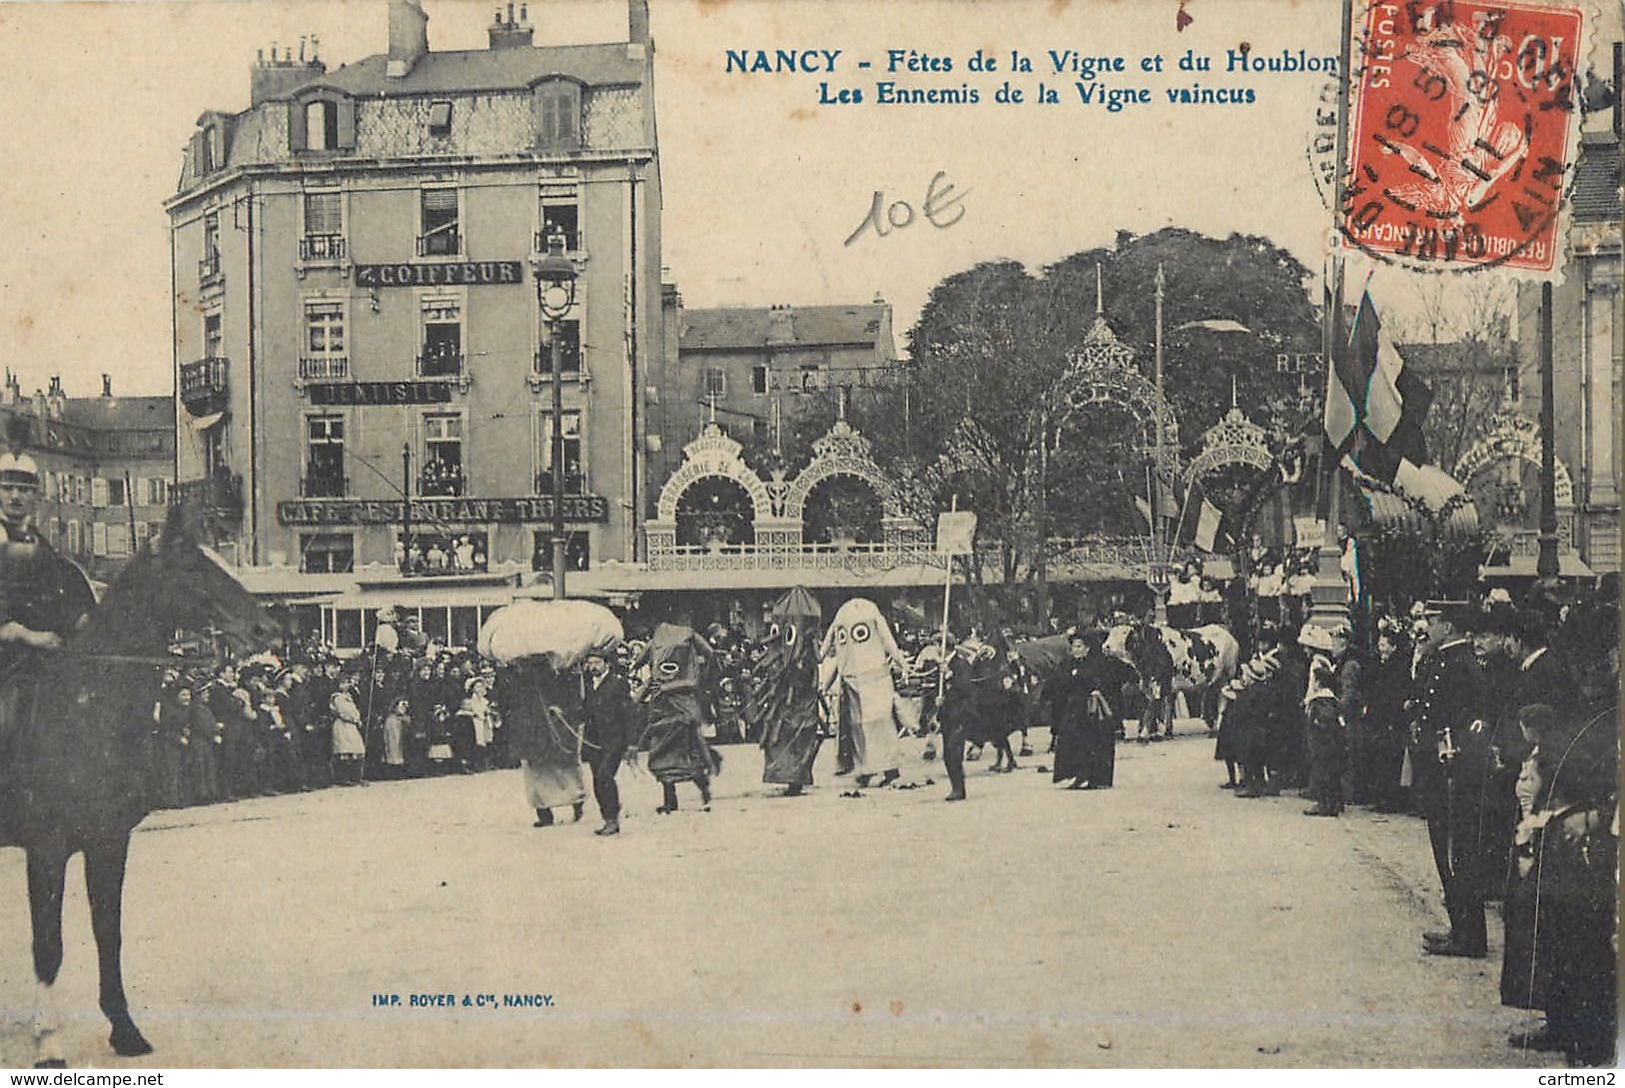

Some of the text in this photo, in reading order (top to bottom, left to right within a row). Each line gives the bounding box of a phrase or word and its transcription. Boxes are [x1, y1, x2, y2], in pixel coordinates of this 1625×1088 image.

[725, 48, 842, 74] NANCY
[888, 47, 953, 74] Fêtes
[967, 49, 997, 73] de
[1011, 49, 1034, 74] la
[1048, 48, 1127, 80] Vigne
[1139, 53, 1164, 74] et
[1178, 49, 1212, 73] du
[1226, 47, 1338, 74] Houblon
[819, 81, 1256, 113] Les Ennemis de la Vigne vaincus
[380, 262, 515, 284] COIFFEUR
[515, 499, 604, 519] THIERS
[371, 993, 402, 1007] IMP.
[409, 993, 456, 1007] ROYER
[461, 993, 473, 1007] &
[503, 993, 556, 1007] NANCY.
